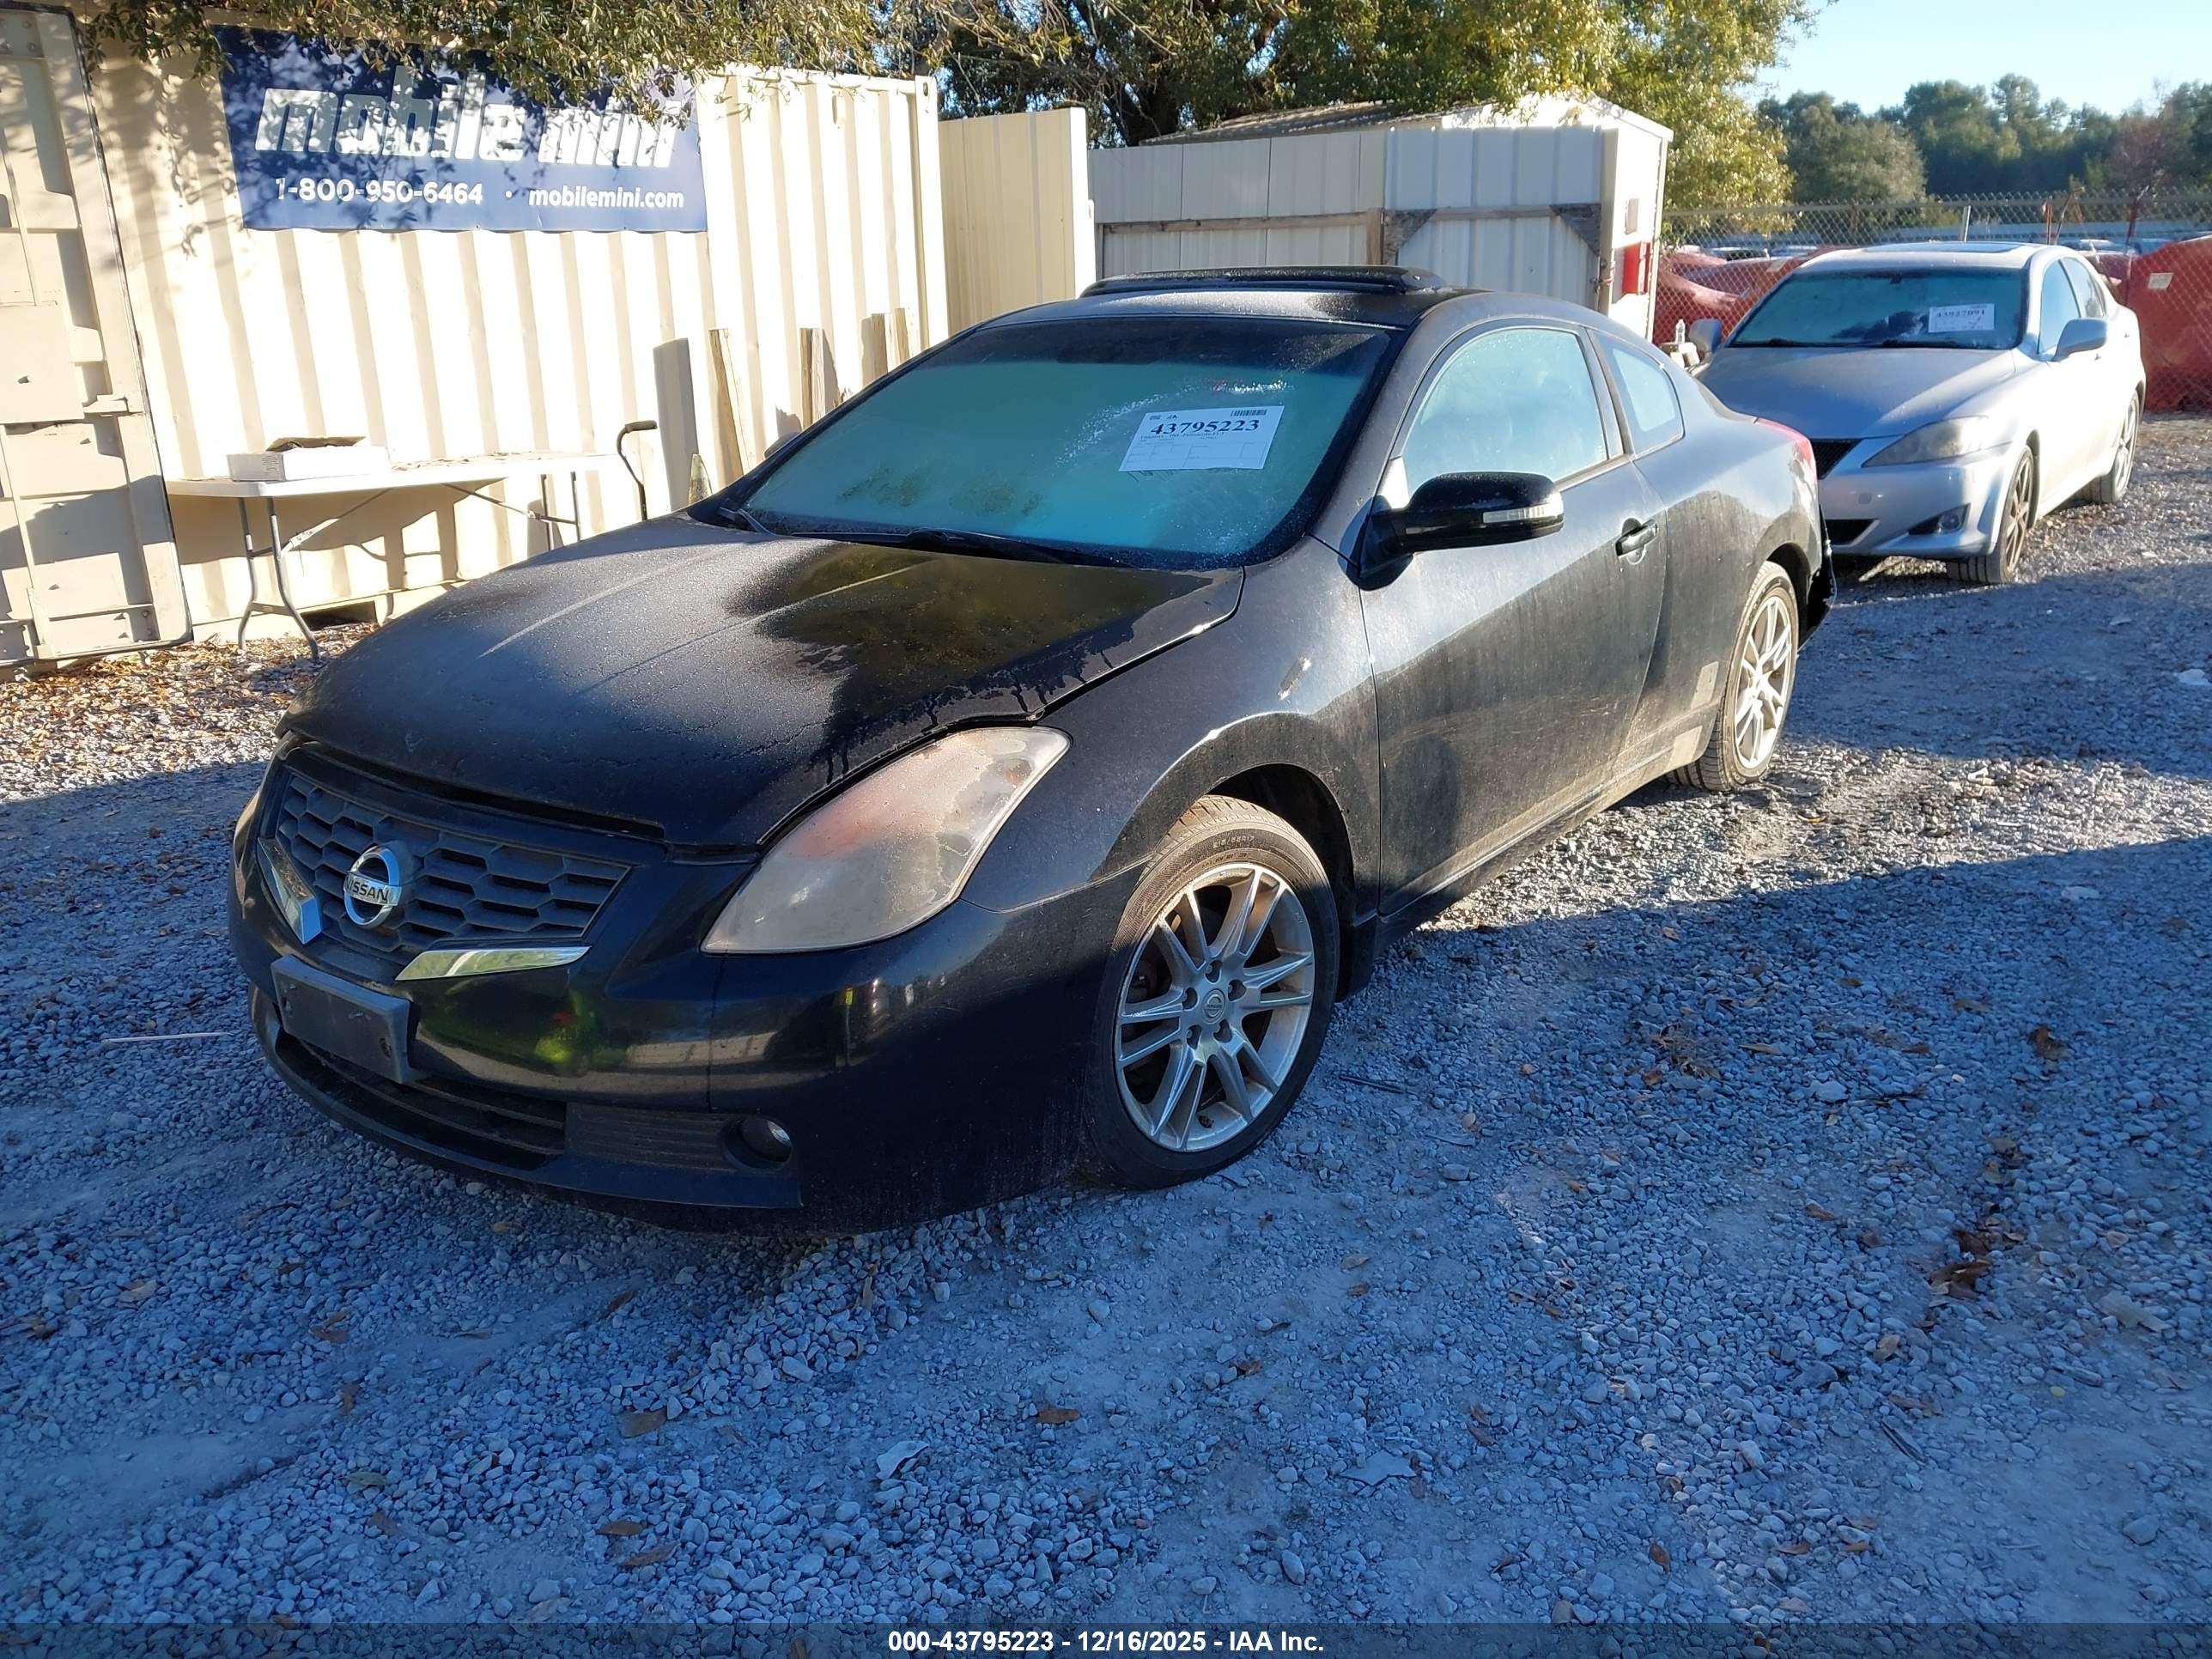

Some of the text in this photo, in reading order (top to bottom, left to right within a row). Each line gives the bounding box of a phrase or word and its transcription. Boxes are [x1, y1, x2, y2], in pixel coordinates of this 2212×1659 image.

[255, 65, 683, 167] mobile mini
[274, 176, 685, 208] 1-800-950-6464 mobilemini.com
[1150, 419, 1260, 435] 43795223
[346, 877, 389, 902] NISSAN
